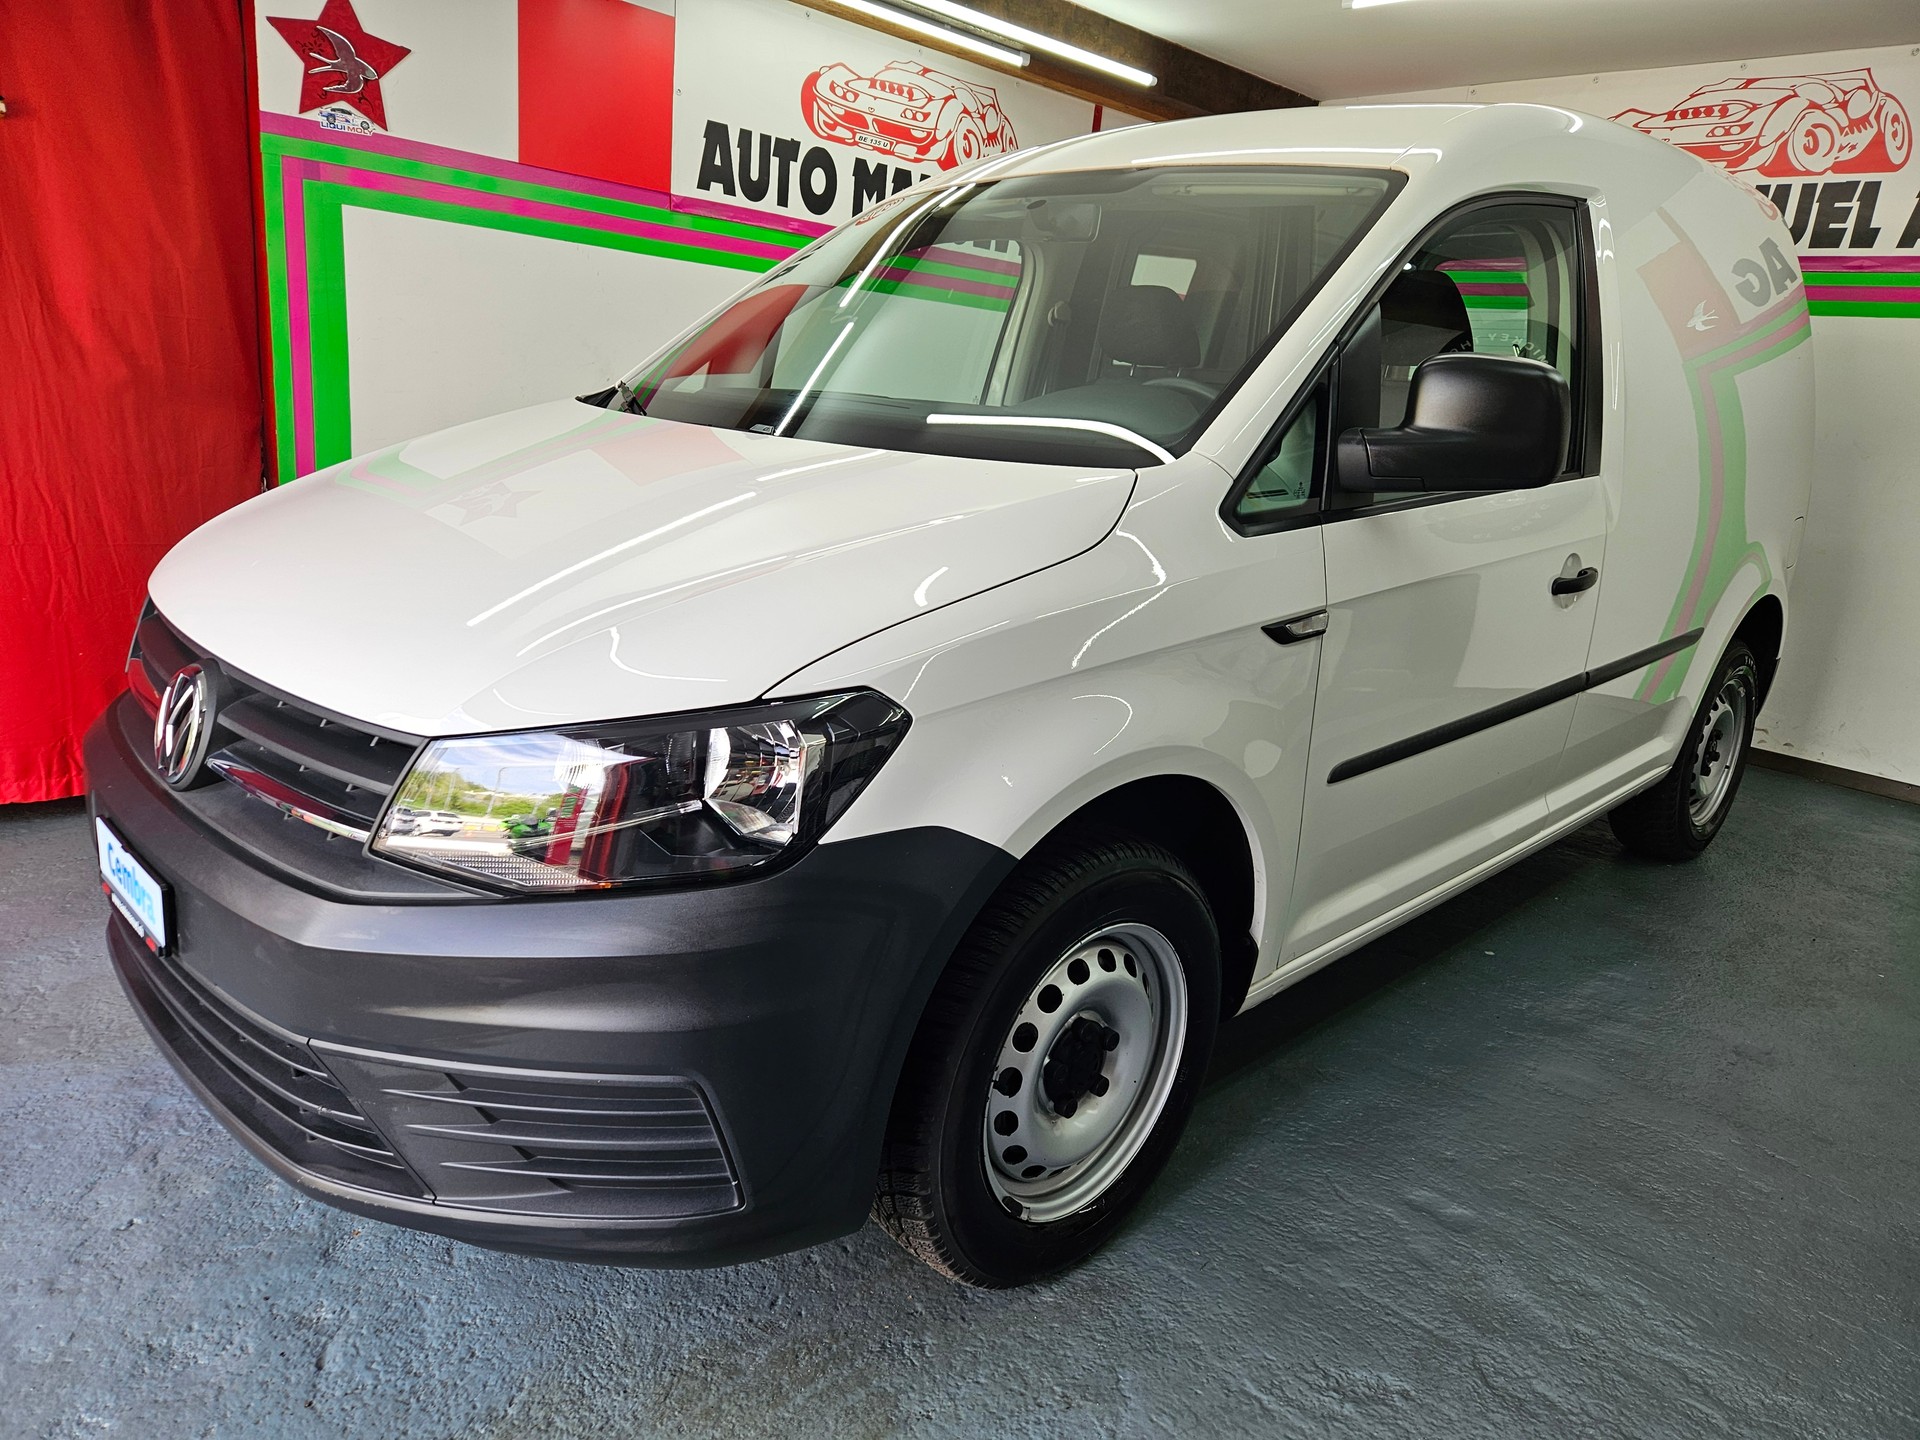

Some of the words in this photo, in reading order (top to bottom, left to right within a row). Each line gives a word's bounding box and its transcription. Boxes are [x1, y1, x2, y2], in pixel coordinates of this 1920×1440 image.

[321, 121, 346, 131] LIQUI
[347, 125, 374, 135] MOLY
[858, 135, 868, 143] BE
[870, 138, 881, 146] 135
[697, 119, 837, 216] AUTO
[1755, 180, 1883, 249] UEL
[107, 841, 157, 926] Cembra
